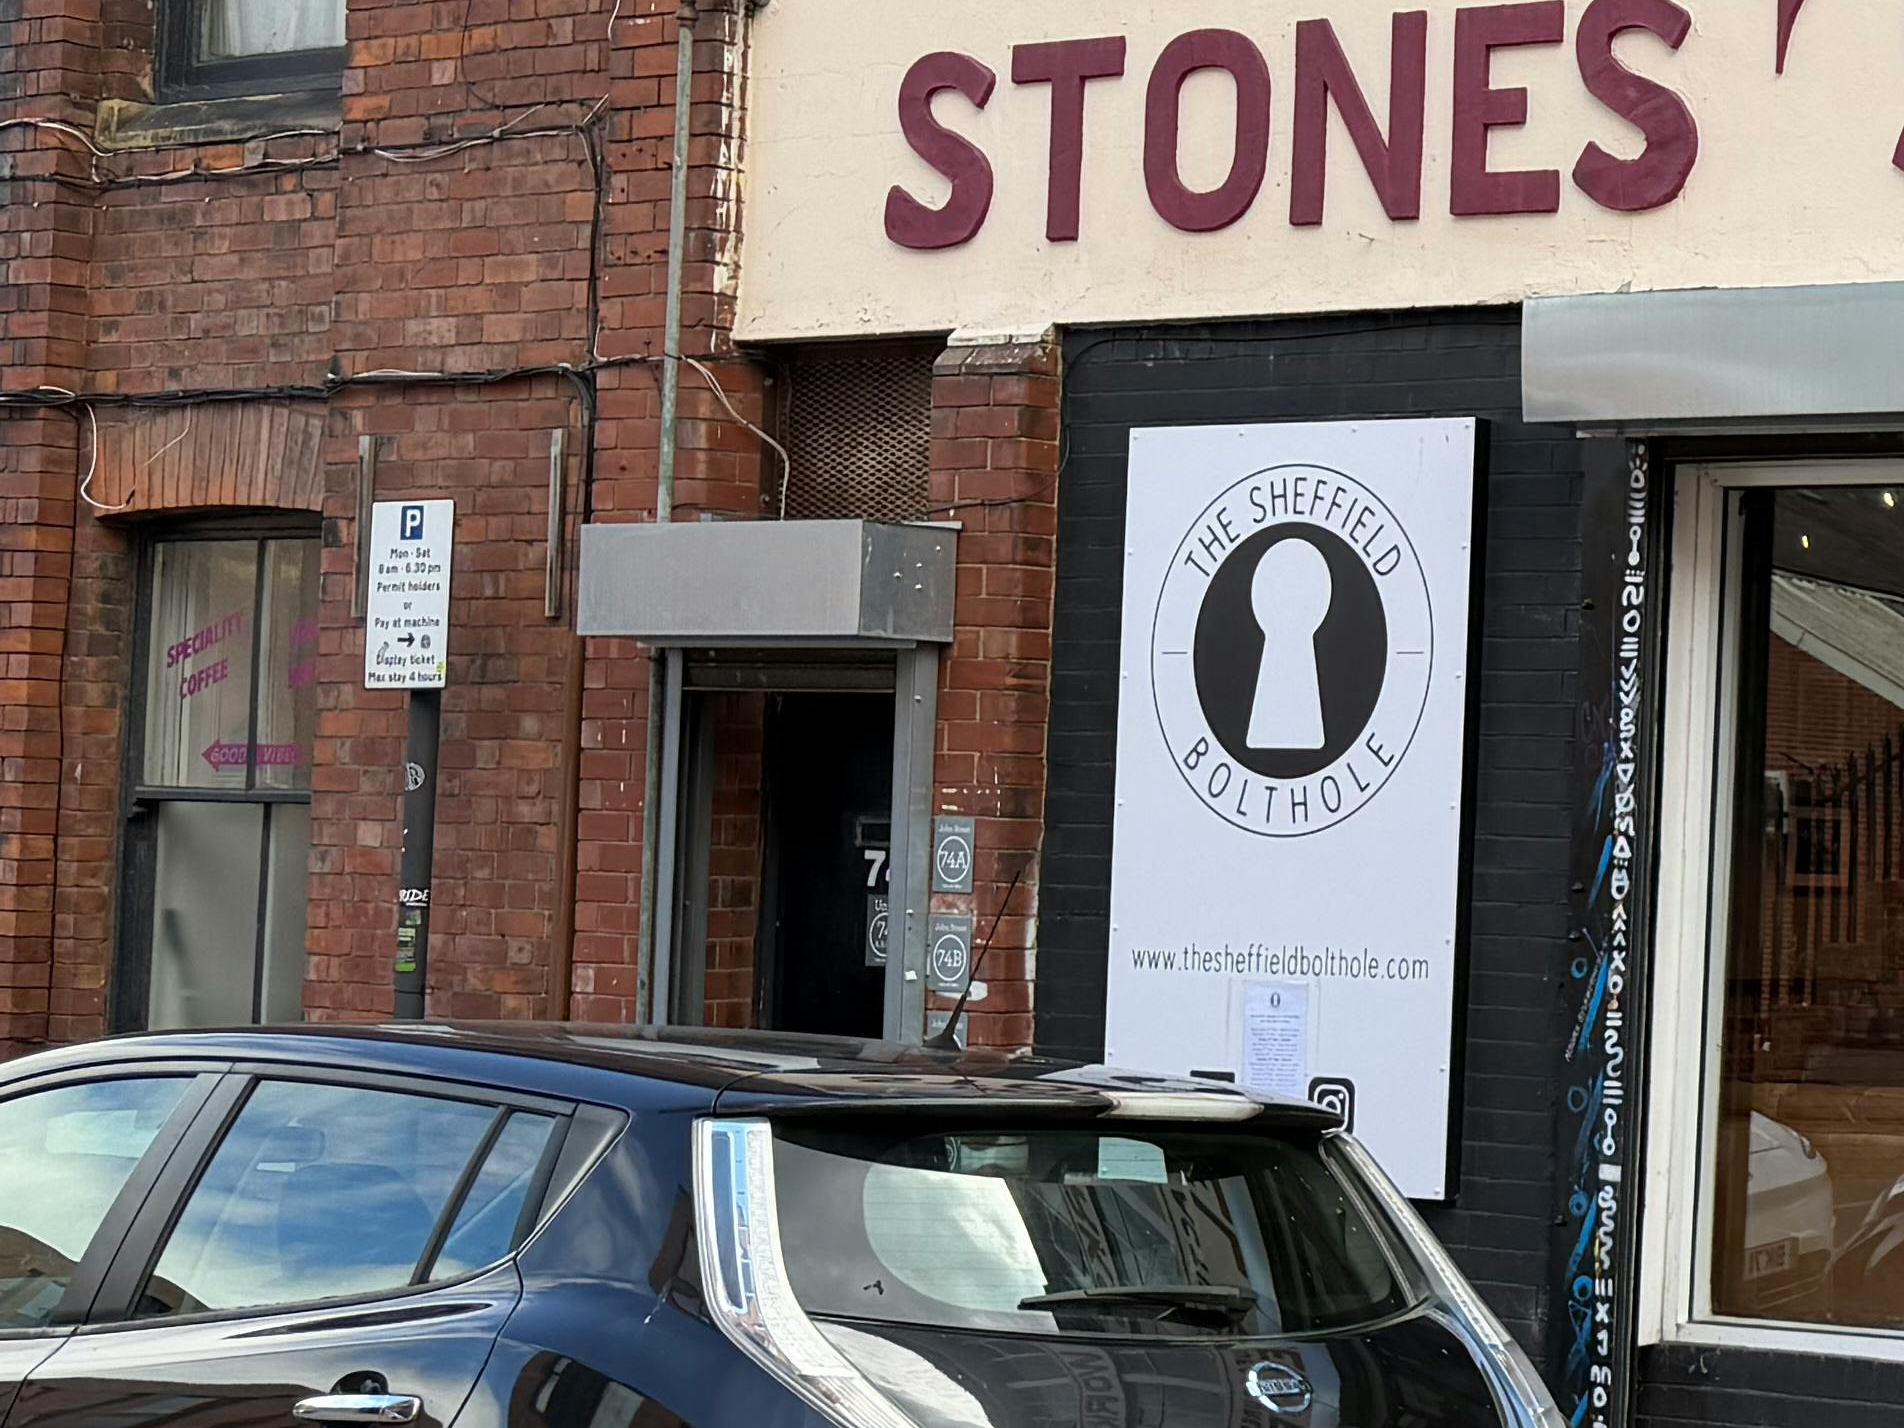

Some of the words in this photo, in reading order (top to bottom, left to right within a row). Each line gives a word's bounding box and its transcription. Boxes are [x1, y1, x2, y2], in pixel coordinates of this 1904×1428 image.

[405, 508, 421, 538] P
[1184, 507, 1242, 578] THE
[1249, 477, 1402, 577] SHEFFIELD
[390, 548, 408, 559] Mon
[416, 547, 431, 558] Sat
[377, 582, 405, 593] Permit
[408, 581, 440, 592] holders
[403, 601, 412, 610] or
[375, 617, 389, 629] Pay
[393, 618, 401, 628] at
[404, 617, 440, 627] machine
[410, 653, 435, 665] ticket
[179, 657, 228, 700] COFFEE
[368, 673, 386, 683] Max
[388, 673, 406, 683] stay
[409, 672, 416, 681] 4
[417, 671, 442, 682] hours
[210, 747, 248, 763] GOOD
[1182, 732, 1396, 824] BOLTHOLE
[940, 851, 967, 869] 74A
[937, 949, 962, 967] 74B
[1131, 943, 1430, 980] www.thesheffieldbolthole.com
